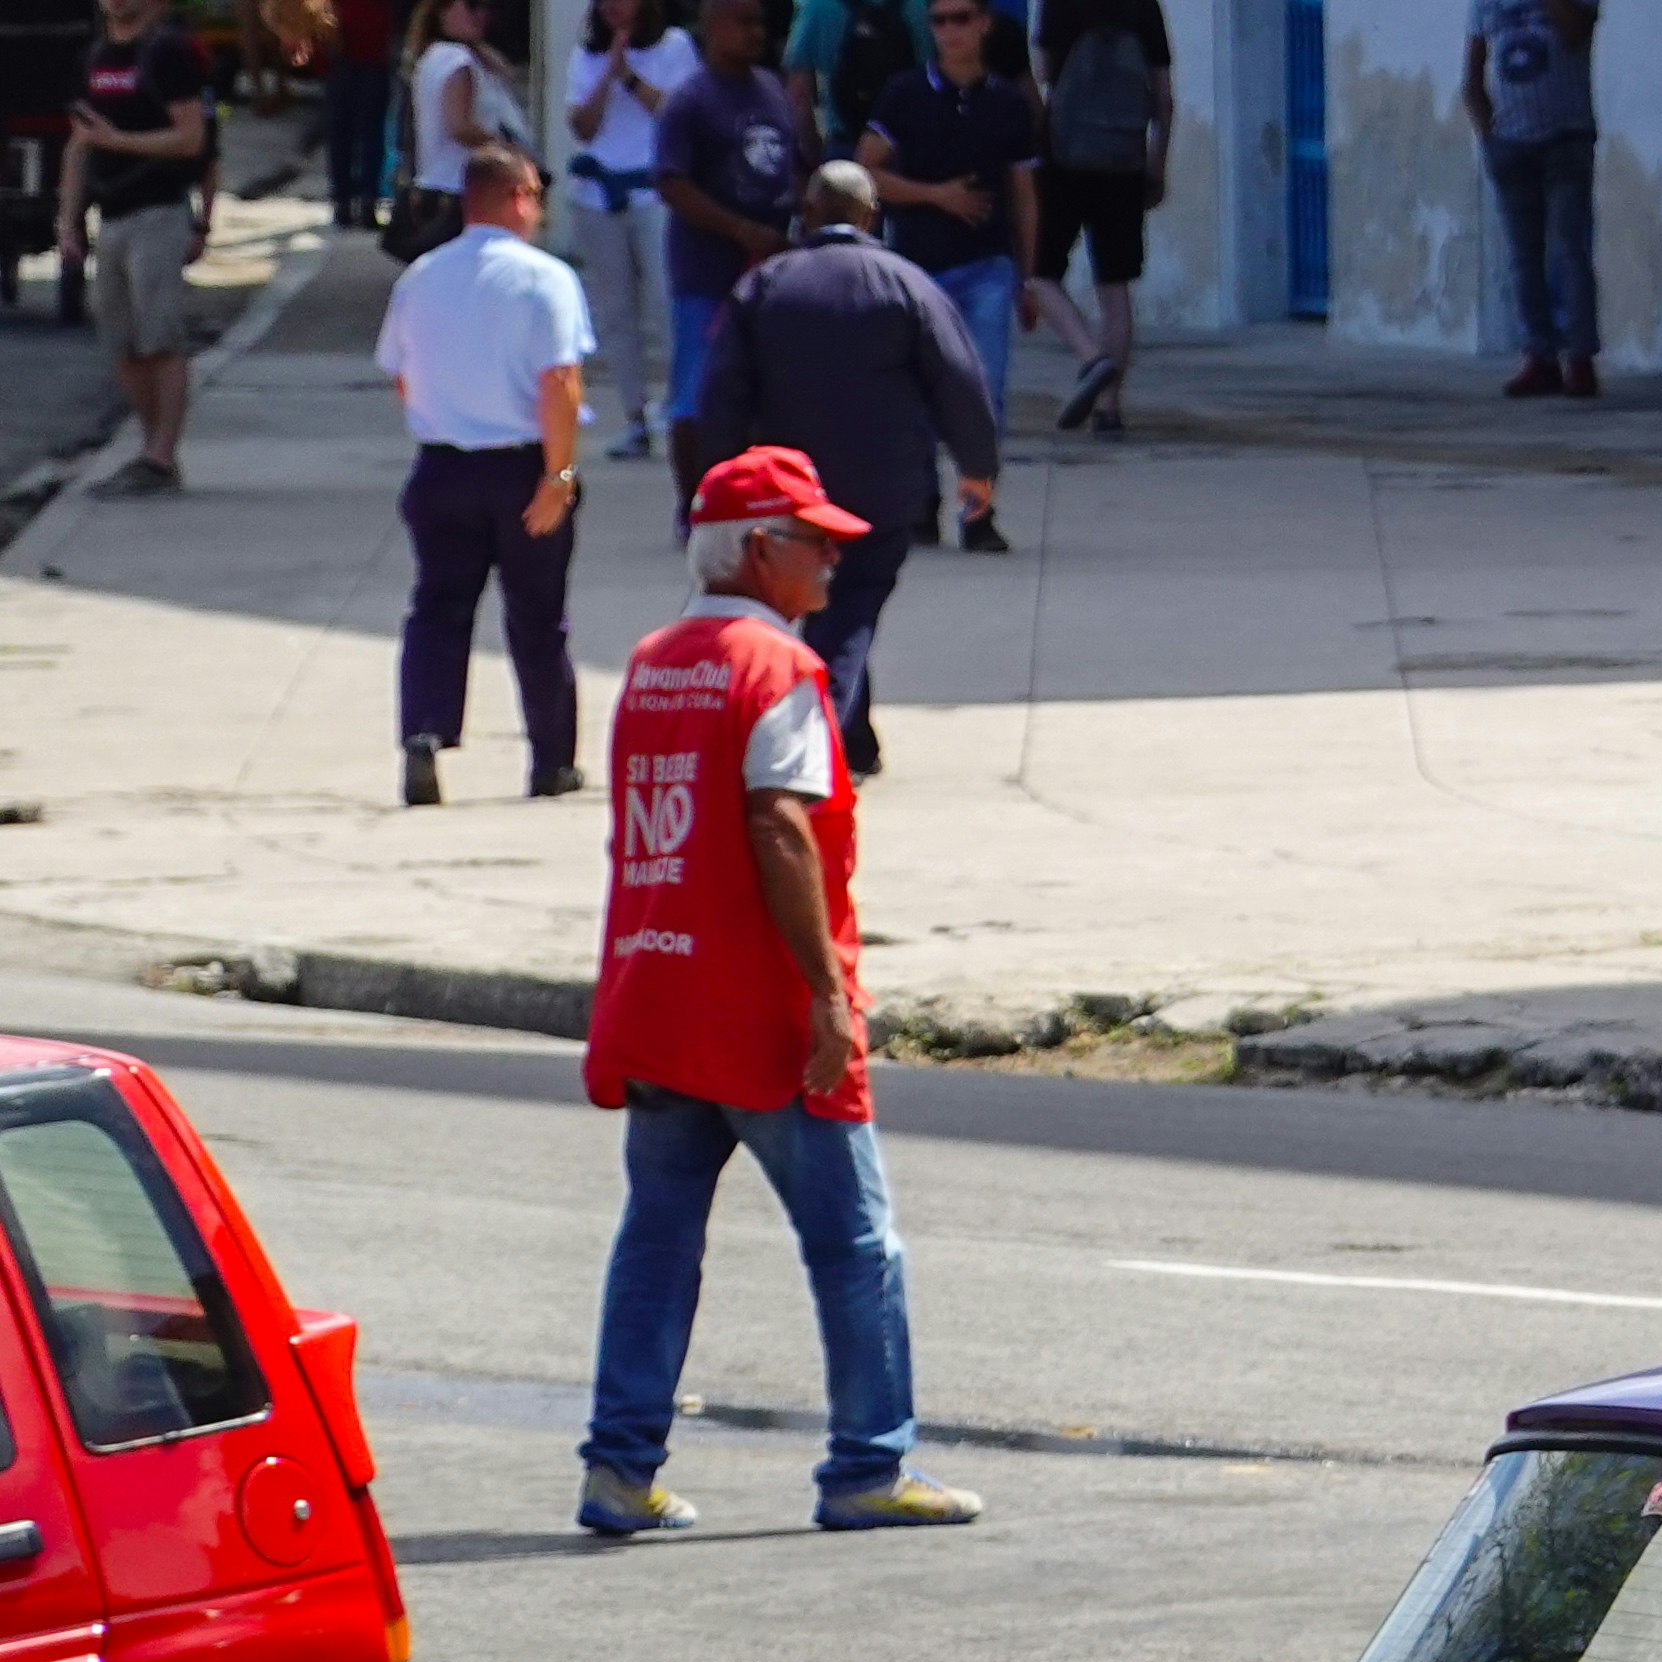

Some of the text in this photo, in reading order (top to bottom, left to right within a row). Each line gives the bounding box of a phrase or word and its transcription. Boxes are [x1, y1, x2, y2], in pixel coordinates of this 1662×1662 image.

[626, 751, 699, 784] SI BEBE
[624, 784, 694, 857] NO
